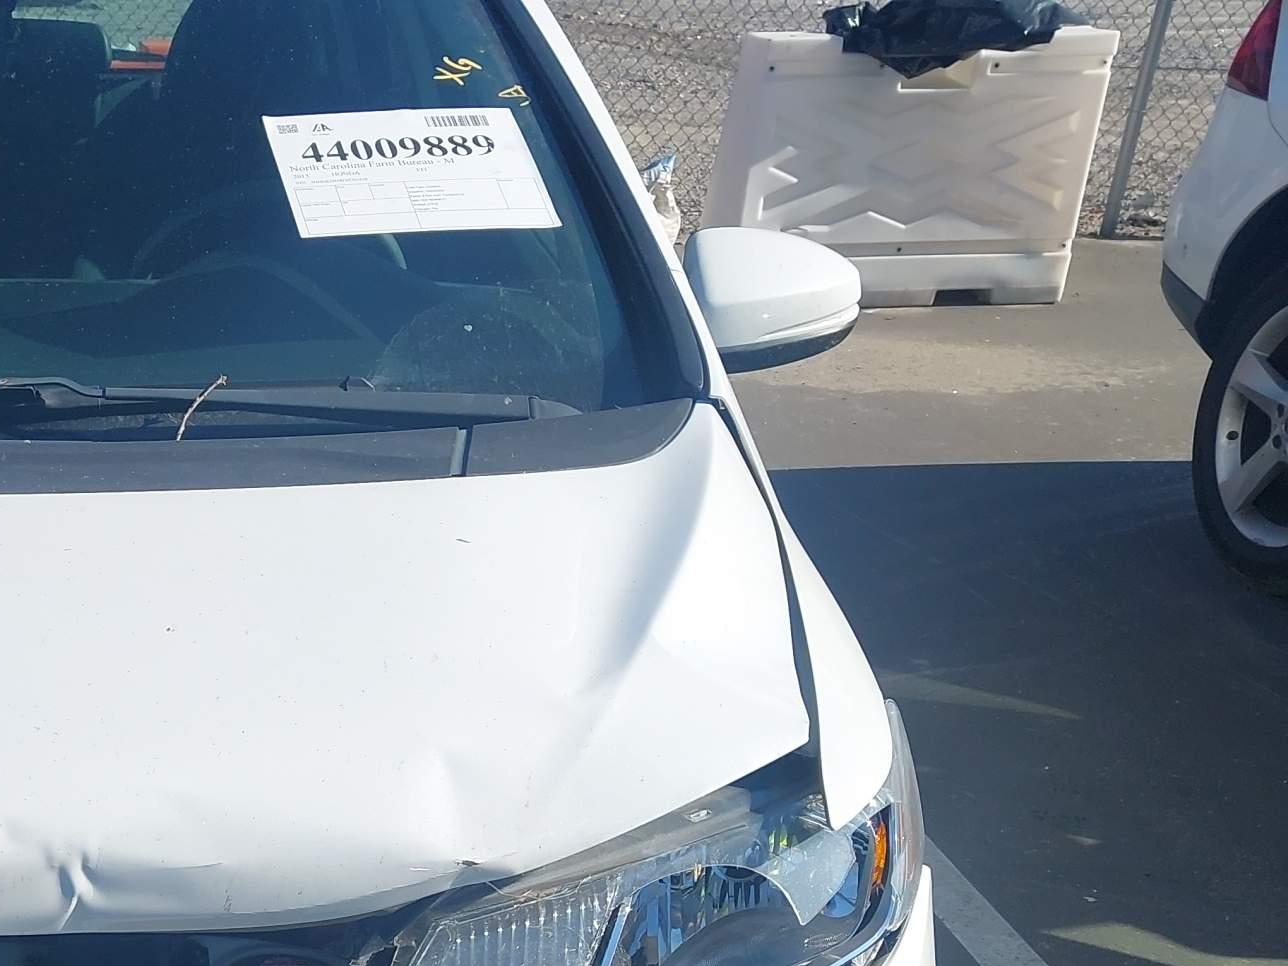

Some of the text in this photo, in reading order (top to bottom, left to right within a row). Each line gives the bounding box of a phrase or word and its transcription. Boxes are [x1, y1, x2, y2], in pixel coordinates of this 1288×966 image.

[302, 135, 495, 162] 44009889
[289, 164, 319, 172] North
[322, 161, 366, 171] Carolina
[369, 160, 395, 168] Farm
[398, 158, 434, 166] Bureau
